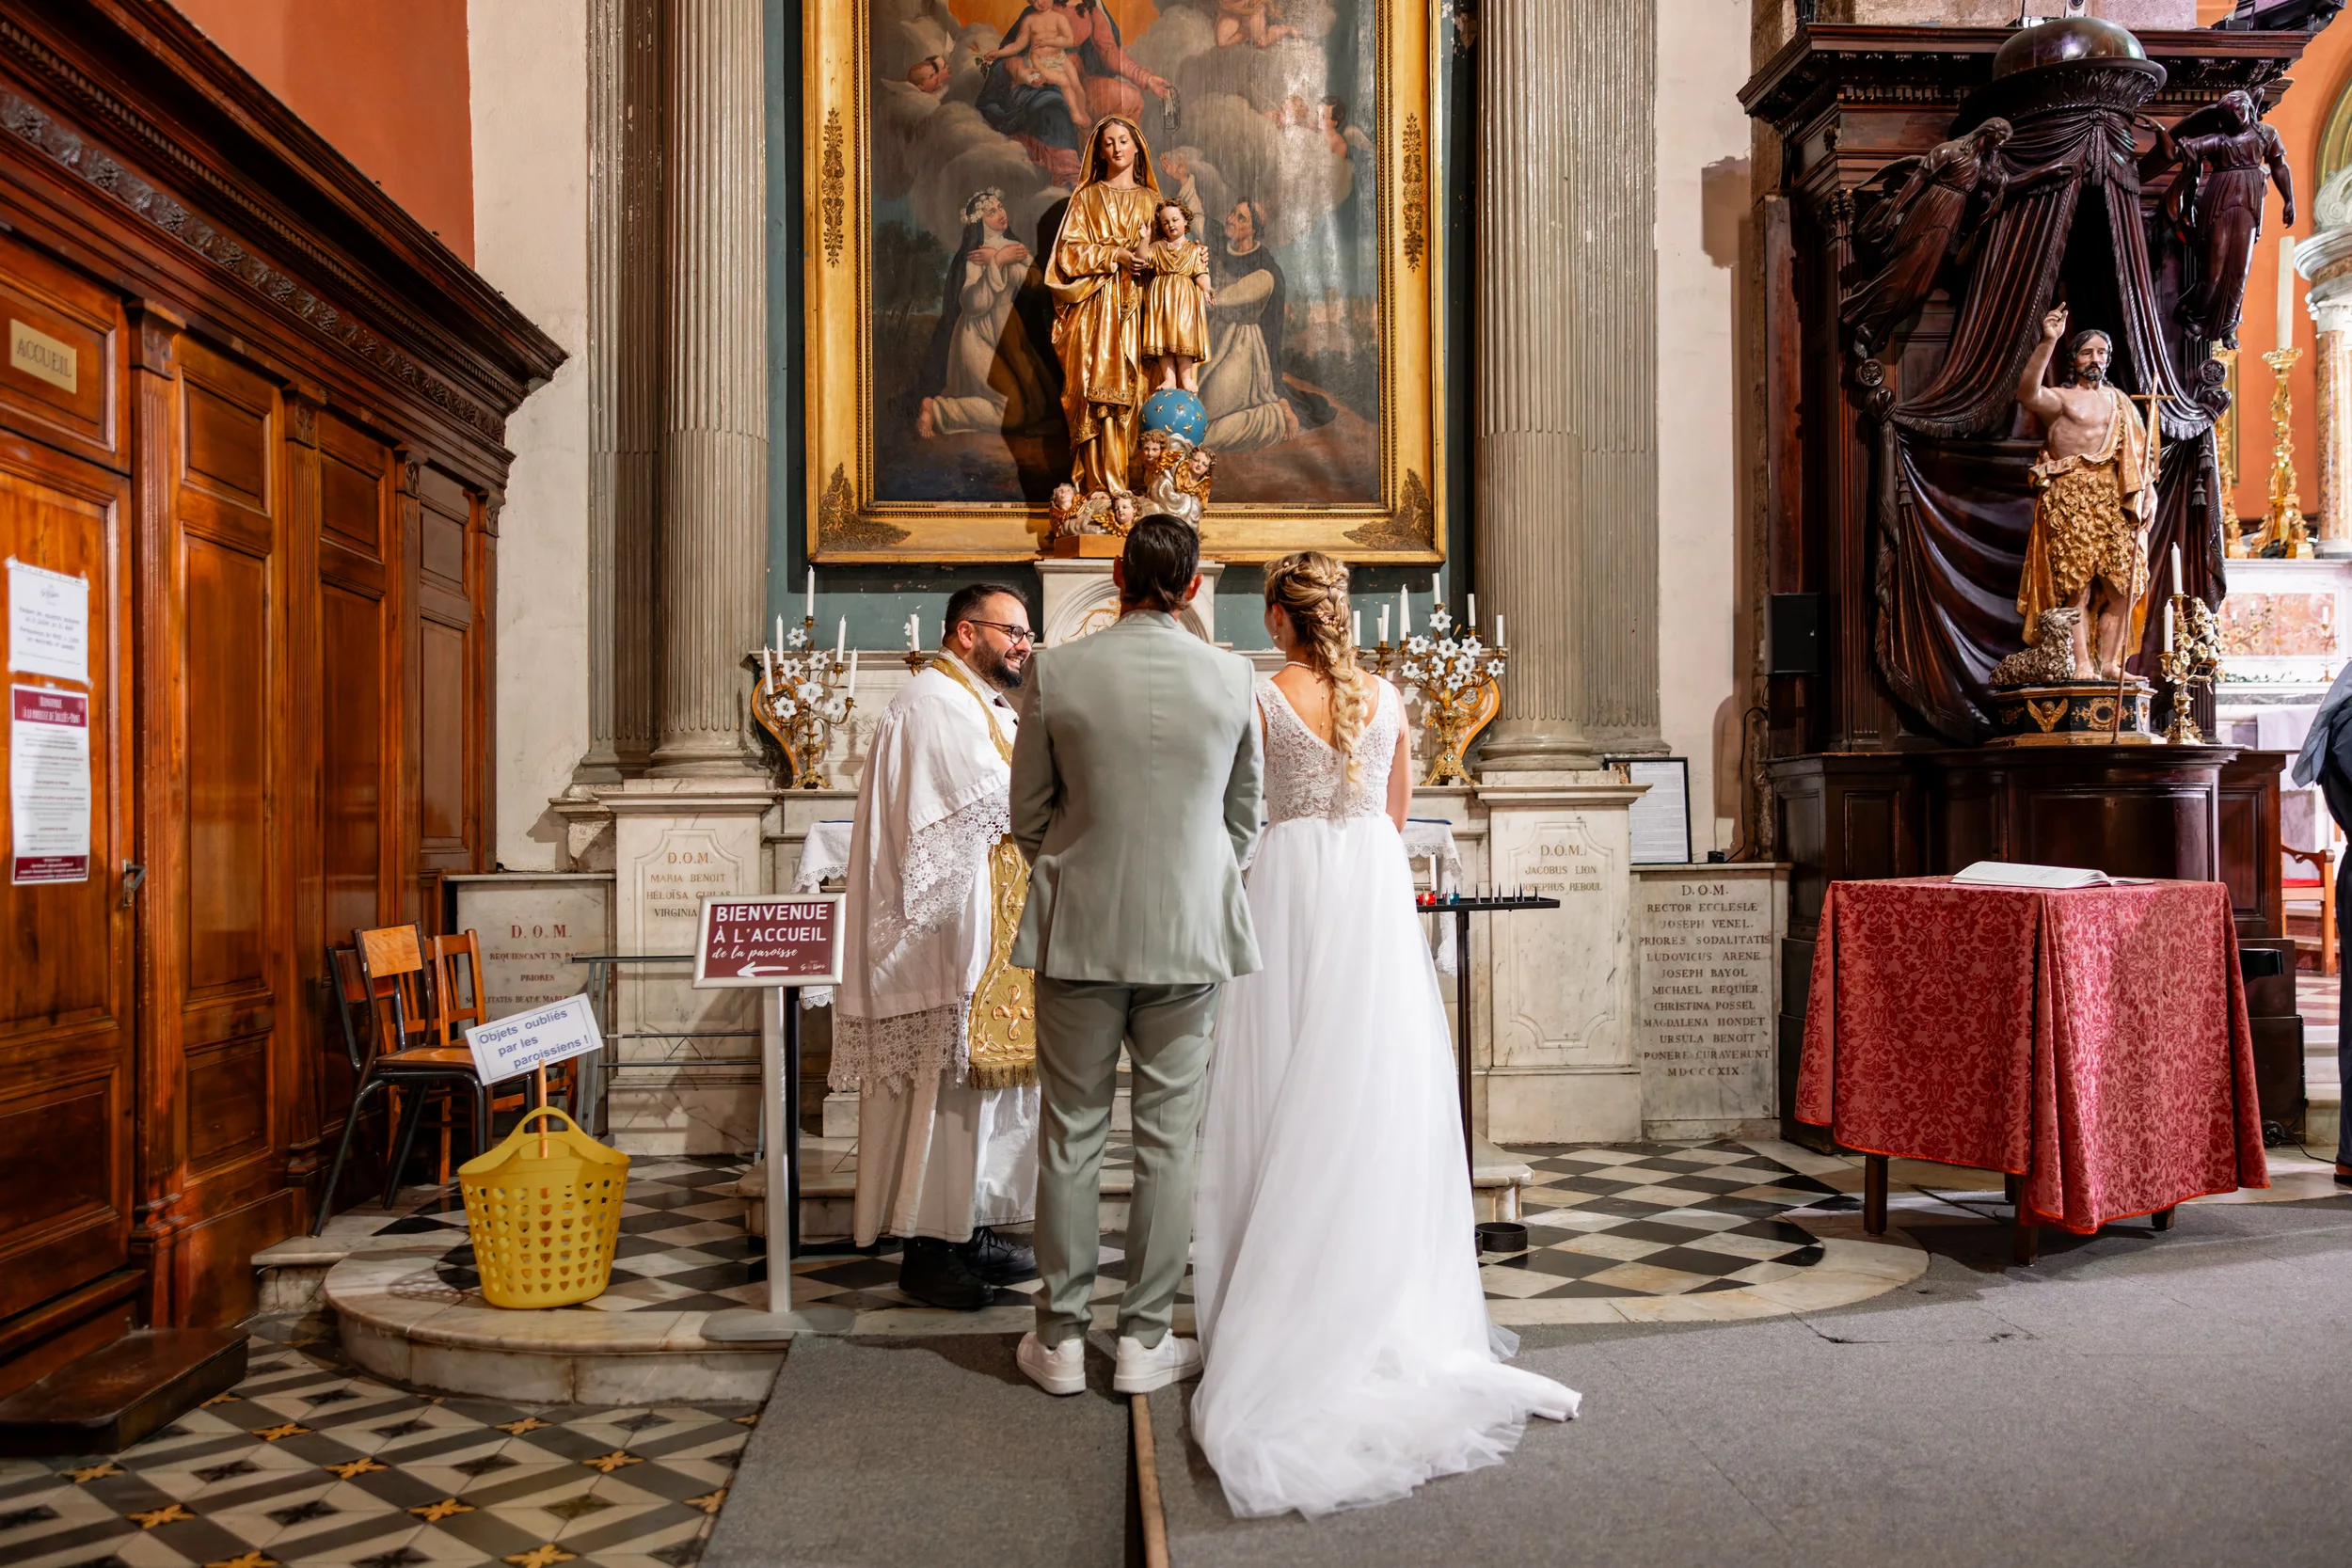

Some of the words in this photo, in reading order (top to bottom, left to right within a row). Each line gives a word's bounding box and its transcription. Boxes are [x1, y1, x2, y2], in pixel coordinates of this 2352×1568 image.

[17, 338, 72, 377] ACCUEIL
[1541, 845, 1583, 856] D.O.M.
[668, 852, 713, 863] D.O.M.
[1525, 865, 1567, 875] JACOBUS
[1575, 865, 1597, 875] LION
[691, 874, 726, 882] BENOIT
[1522, 882, 1565, 892] JOSEPHUS
[1569, 882, 1603, 892] REBOUL
[654, 909, 697, 917] VIRGINIA
[1647, 904, 1692, 912] RECTOR
[716, 905, 828, 922] BIENVENUE
[1661, 920, 1705, 929] JOSEPH
[1712, 919, 1754, 927] VENEL.
[713, 926, 726, 943] À
[734, 927, 827, 942] L'ACCUEIL
[1639, 937, 1686, 946] PRIORES
[1696, 935, 1771, 944] SODALITATIS
[489, 953, 546, 962] REQUIESCANT
[712, 947, 727, 958] de
[730, 945, 745, 959] la
[747, 947, 798, 961] paroisse
[1646, 953, 1712, 961] LUDOVICUS
[1723, 952, 1760, 960] ARENE
[1661, 969, 1703, 978] JOSEPH
[1652, 986, 1702, 995] MICHAEL
[1711, 985, 1763, 995] REQUIER.
[1654, 1002, 1710, 1010] CHRISTINA
[1716, 1001, 1756, 1010] POSSEL
[480, 1026, 518, 1044] Objets
[525, 1010, 568, 1029] oubliés
[1644, 1019, 1708, 1027] MAGDALENA
[1660, 1035, 1704, 1043] URSULA
[1713, 1034, 1756, 1043] BENOIT
[499, 1042, 517, 1057] par
[520, 1037, 538, 1048] les
[514, 1038, 581, 1069] paroissiens
[583, 1035, 589, 1044] !
[1645, 1052, 1689, 1061] PONERE
[1696, 1050, 1770, 1059] CURAVERUNT
[1667, 1067, 1744, 1076] MDCCCXIX.
